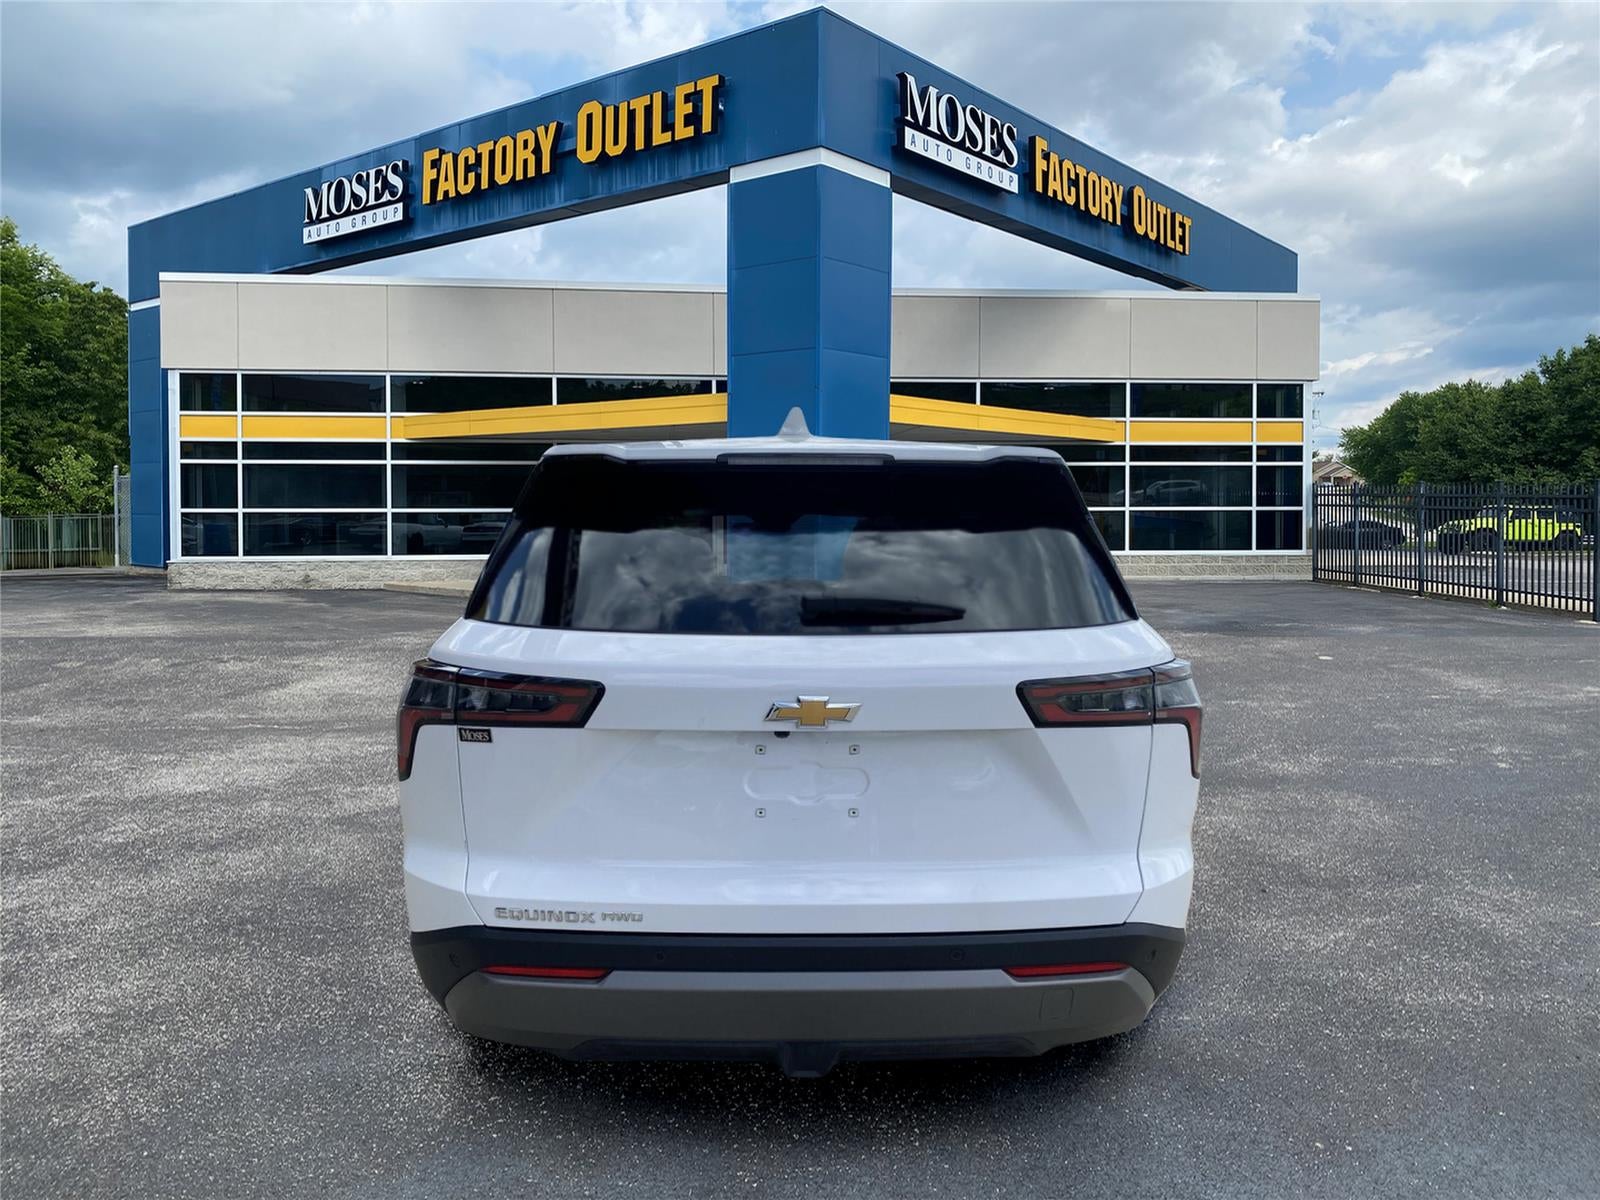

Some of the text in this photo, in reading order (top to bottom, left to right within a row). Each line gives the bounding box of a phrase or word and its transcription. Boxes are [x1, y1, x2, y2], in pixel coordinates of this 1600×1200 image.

[421, 74, 720, 205] FACTORY OUTLET
[903, 72, 1019, 168] MOSES
[303, 160, 404, 223] MOSES
[910, 133, 1015, 188] AUTO GROUP
[306, 206, 399, 240] AUTO GROUP
[1034, 135, 1193, 255] FACTORY OUTLET
[495, 907, 595, 923] EQUINOX
